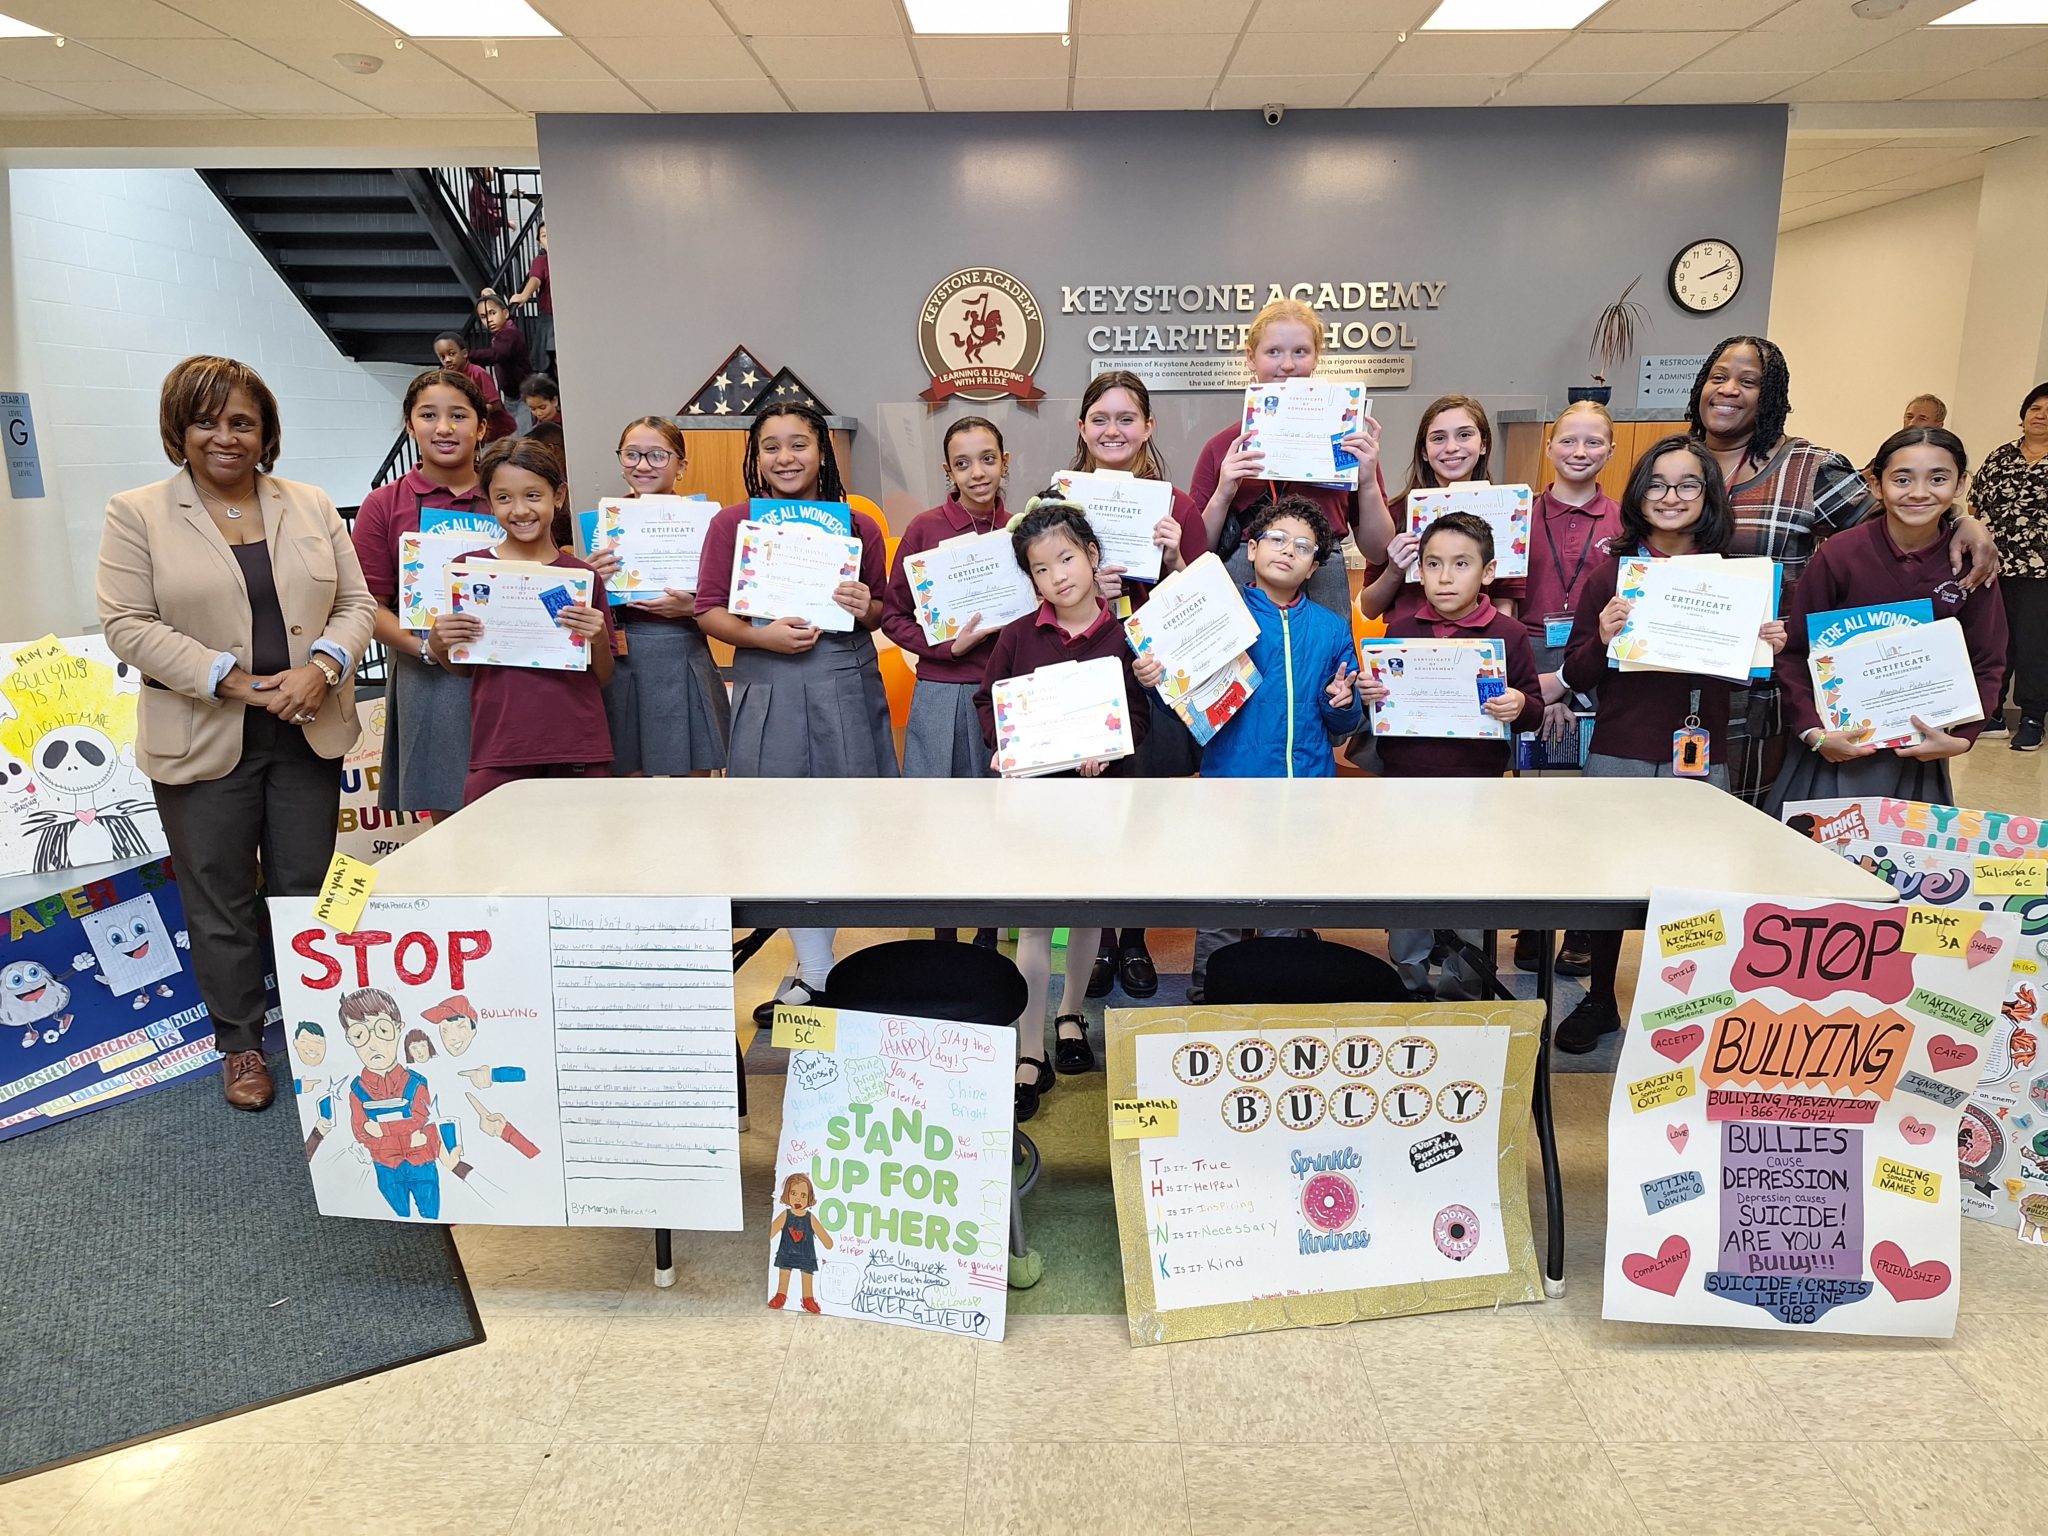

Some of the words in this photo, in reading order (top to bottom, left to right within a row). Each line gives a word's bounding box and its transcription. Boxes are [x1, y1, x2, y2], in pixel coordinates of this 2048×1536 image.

[924, 271, 980, 324] KEYSTONE
[983, 271, 1038, 322] ACADEMY
[1061, 283, 1255, 313] KEYSTONE
[1263, 281, 1446, 309] ACADEMY
[1153, 361, 1189, 370] Keystone
[1190, 360, 1225, 370] Academy
[1334, 357, 1367, 367] rigorous
[1367, 357, 1405, 365] academic
[1161, 369, 1213, 378] concentrated
[1213, 369, 1242, 377] science
[1311, 367, 1354, 376] curriculum
[1373, 366, 1405, 375] employs
[1659, 358, 1707, 367] RESTROOMS
[939, 369, 980, 384] LEARNING
[981, 368, 989, 377] &
[989, 369, 1025, 383] LEADING
[954, 377, 976, 387] WITH
[977, 376, 1009, 387] P.R.I.D.E.
[1189, 379, 1201, 387] the
[1217, 379, 1226, 387] of
[0, 395, 20, 405] STAIR
[1657, 387, 1675, 395] GYM
[9, 418, 29, 447] G
[780, 505, 799, 520] ALL
[1088, 503, 1143, 515] CERTIFICATE
[453, 517, 473, 532] ALL
[948, 562, 1001, 580] CERTIFICATE
[1664, 593, 1733, 611] CERTIFICATE
[1162, 595, 1208, 631] CERTIFICATE
[1844, 616, 1868, 634] ALL
[16, 648, 41, 667] Milly
[1862, 654, 1932, 677] CERTIFICATE
[12, 658, 88, 693] BULLYING
[31, 689, 48, 706] IS
[58, 684, 69, 701] A
[1819, 809, 1862, 842] MAKE
[1976, 865, 2027, 879] Juliana
[2014, 878, 2032, 888] 6C
[553, 909, 595, 933] Bulling
[1660, 913, 1716, 935] PUNCHING
[1911, 911, 1961, 927] Asher
[1665, 929, 1714, 948] KICKING
[1938, 934, 1961, 949] 3A
[1969, 939, 1998, 955] SHARE
[291, 928, 493, 991] STOP
[480, 1008, 538, 1020] BULLYING
[1654, 994, 1723, 1021] THREATING
[1915, 991, 1969, 1020] MAKING
[1969, 1012, 1994, 1028] FUN
[794, 1028, 817, 1045] 5C
[887, 1020, 909, 1038] BE
[883, 1037, 930, 1057] HAPPY
[1655, 1032, 1698, 1049] ACCEPT
[1189, 1043, 1425, 1078] DONUT
[1712, 1016, 1906, 1086] BULLYING
[1933, 1046, 1967, 1061] CARE
[806, 1067, 835, 1086] gossip
[909, 1073, 926, 1091] Are
[1629, 1071, 1684, 1096] LEAVING
[884, 1081, 928, 1110] Talented
[947, 1078, 989, 1101] Shine
[1905, 1075, 1965, 1101] IGNORING
[1237, 1089, 1473, 1125] BULLY
[1637, 1094, 1663, 1109] OUT
[1708, 1090, 1782, 1108] BULLYING
[1786, 1094, 1877, 1112] PREVENTION
[1979, 1092, 1990, 1100] an
[1991, 1095, 2018, 1106] enemy
[950, 1103, 989, 1122] Bright
[1138, 1114, 1159, 1128] 5A
[1740, 1105, 1836, 1122] 1-866-716-0424
[825, 1102, 954, 1161] STAND
[1669, 1129, 1690, 1140] LOVE
[1728, 1124, 1850, 1155] BULLIES
[1905, 1124, 1928, 1138] HUG
[1191, 1159, 1232, 1172] True
[1290, 1146, 1363, 1181] Sprinkle
[811, 1155, 870, 1194] UP
[879, 1161, 959, 1207] FOR
[1723, 1166, 1850, 1193] DEPRESSION,
[1881, 1162, 1931, 1185] CALLING
[1643, 1170, 1696, 1197] PUTTING
[1879, 1177, 1917, 1196] NAMES
[1657, 1193, 1688, 1210] DOWN
[1736, 1192, 1792, 1205] Depression
[1794, 1193, 1827, 1205] causes
[1966, 1198, 1995, 1211] Knights
[1440, 1209, 1478, 1235] DONUT
[1738, 1202, 1848, 1228] SUICIDE!
[818, 1197, 980, 1256] OTHERS
[1200, 1219, 1279, 1239] Necessary
[1297, 1228, 1371, 1256] Kindness
[1436, 1227, 1474, 1251] BULLY
[1723, 1228, 1773, 1253] ARE
[1781, 1230, 1822, 1251] YOU
[1831, 1230, 1847, 1250] A
[1206, 1255, 1245, 1272] Kind
[1876, 1259, 1942, 1284] FRIENDSHIP
[868, 1270, 900, 1285] Never
[1706, 1274, 1793, 1292] SUICIDE
[1804, 1278, 1869, 1295] CRISIS
[1754, 1291, 1845, 1307] LIFELINE
[856, 1293, 913, 1315] NEVER
[911, 1304, 959, 1325] GIVE
[962, 1310, 985, 1333] UP
[1779, 1304, 1816, 1324] 988
